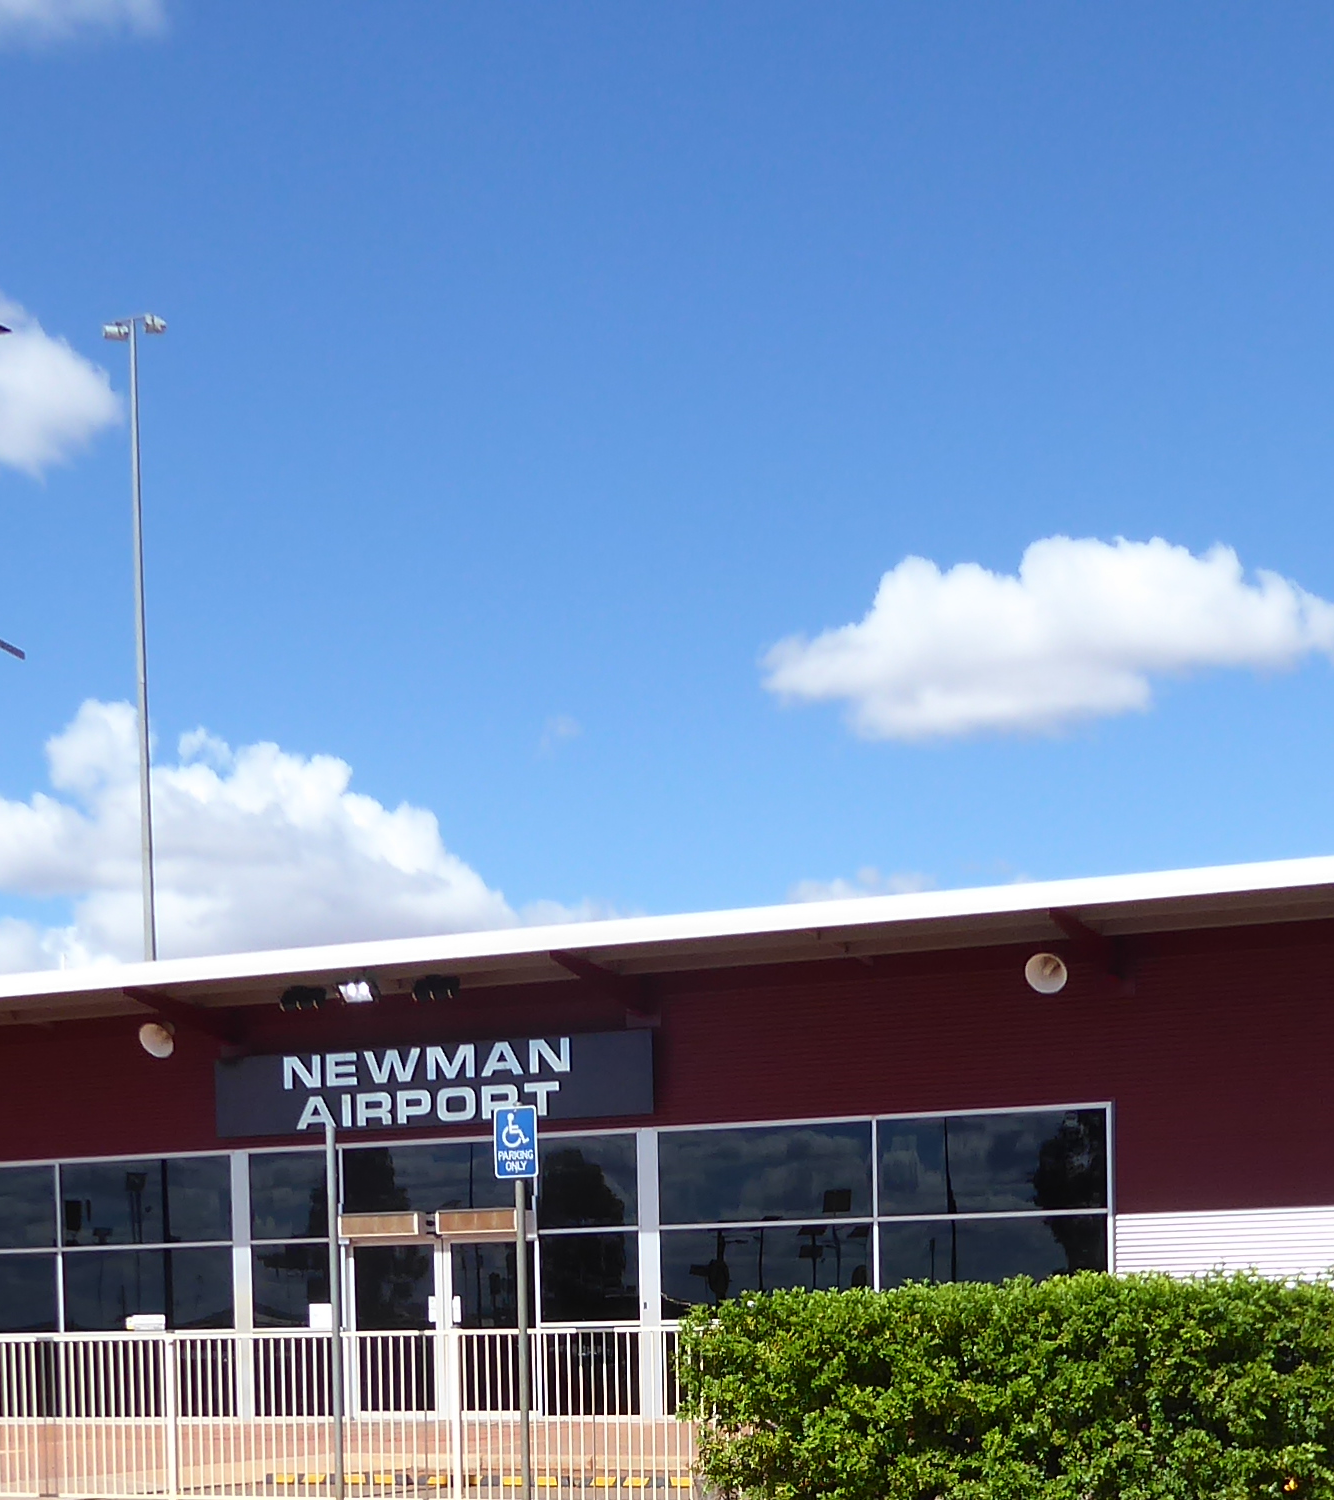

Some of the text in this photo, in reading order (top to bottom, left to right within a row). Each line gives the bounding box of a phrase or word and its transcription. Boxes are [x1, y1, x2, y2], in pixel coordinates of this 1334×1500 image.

[283, 1037, 570, 1089] NEWMAN
[296, 1080, 560, 1130] AIRPORT
[497, 1148, 534, 1161] PARKING
[505, 1161, 527, 1173] ONLY
